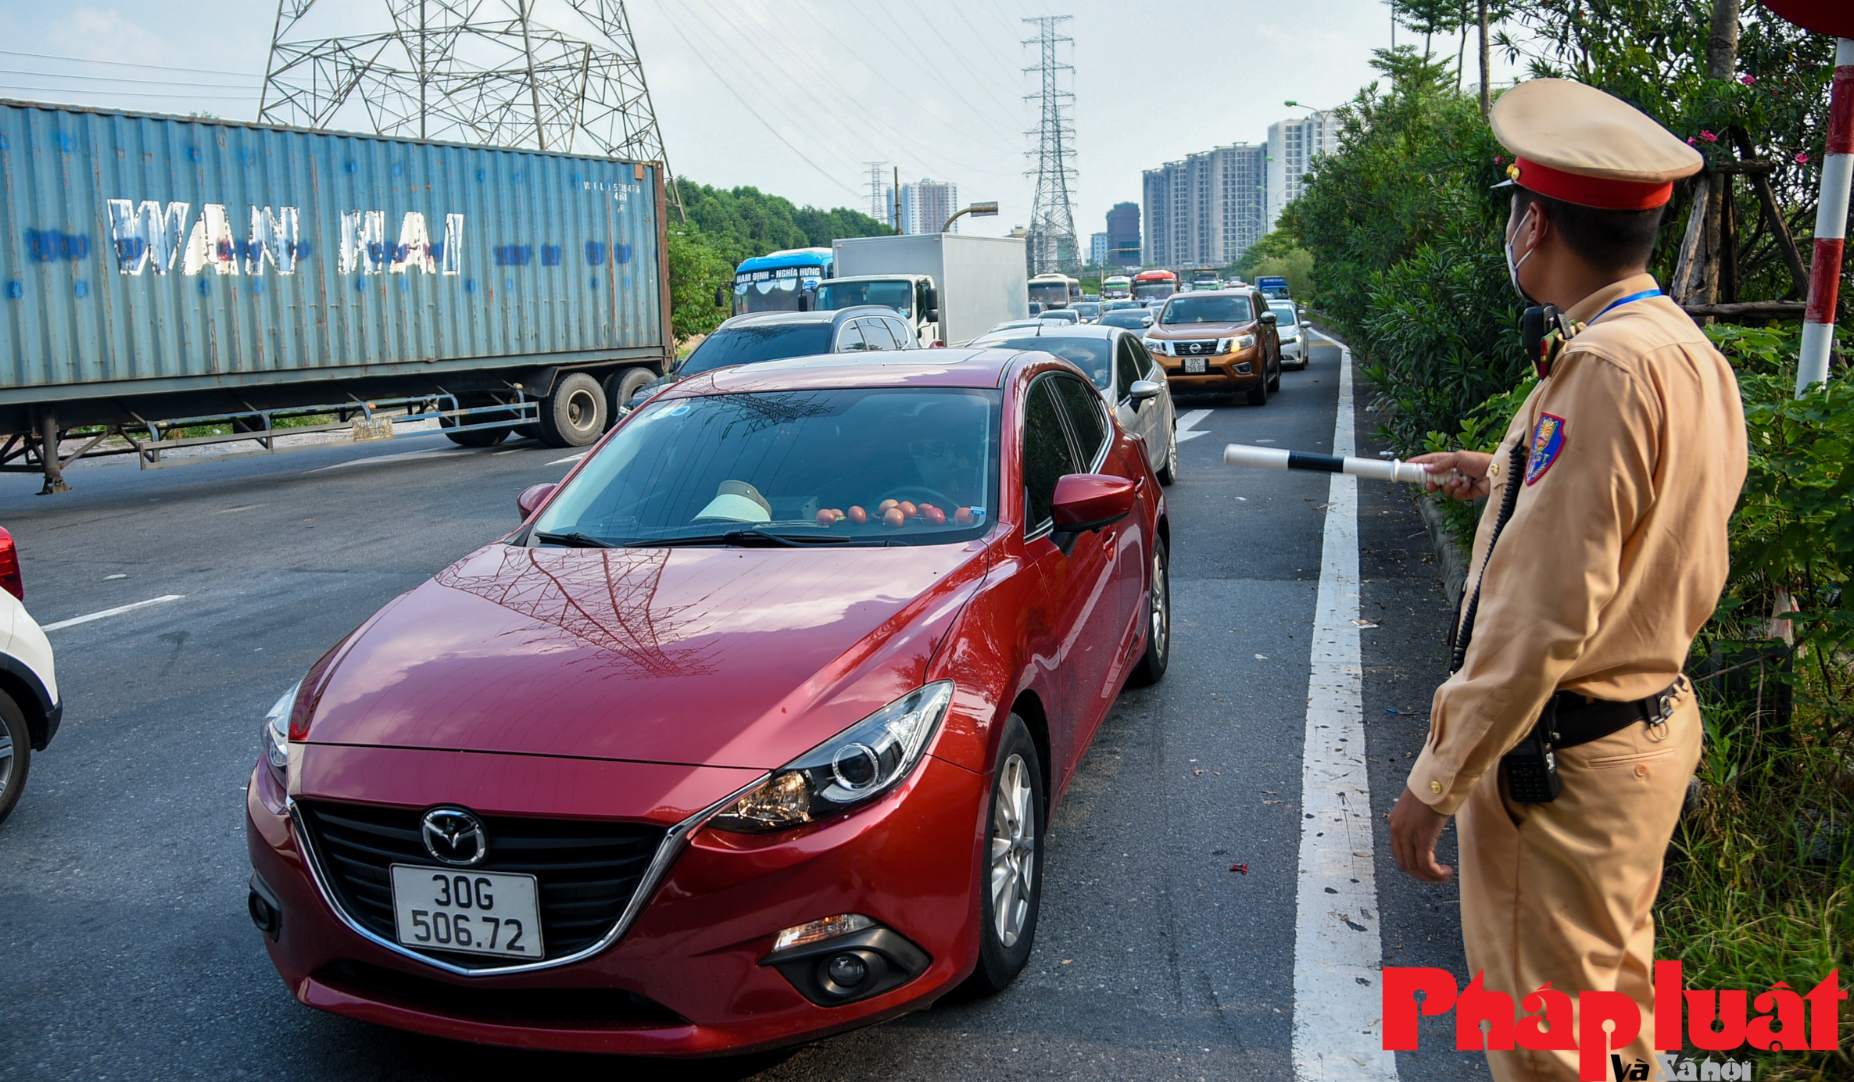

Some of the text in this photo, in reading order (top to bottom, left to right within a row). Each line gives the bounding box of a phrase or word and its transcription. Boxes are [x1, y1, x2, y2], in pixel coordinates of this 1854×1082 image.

[107, 198, 464, 276] WAN HAI
[736, 273, 751, 284] NAM
[432, 873, 494, 911] 30G
[412, 909, 525, 952] 506.72
